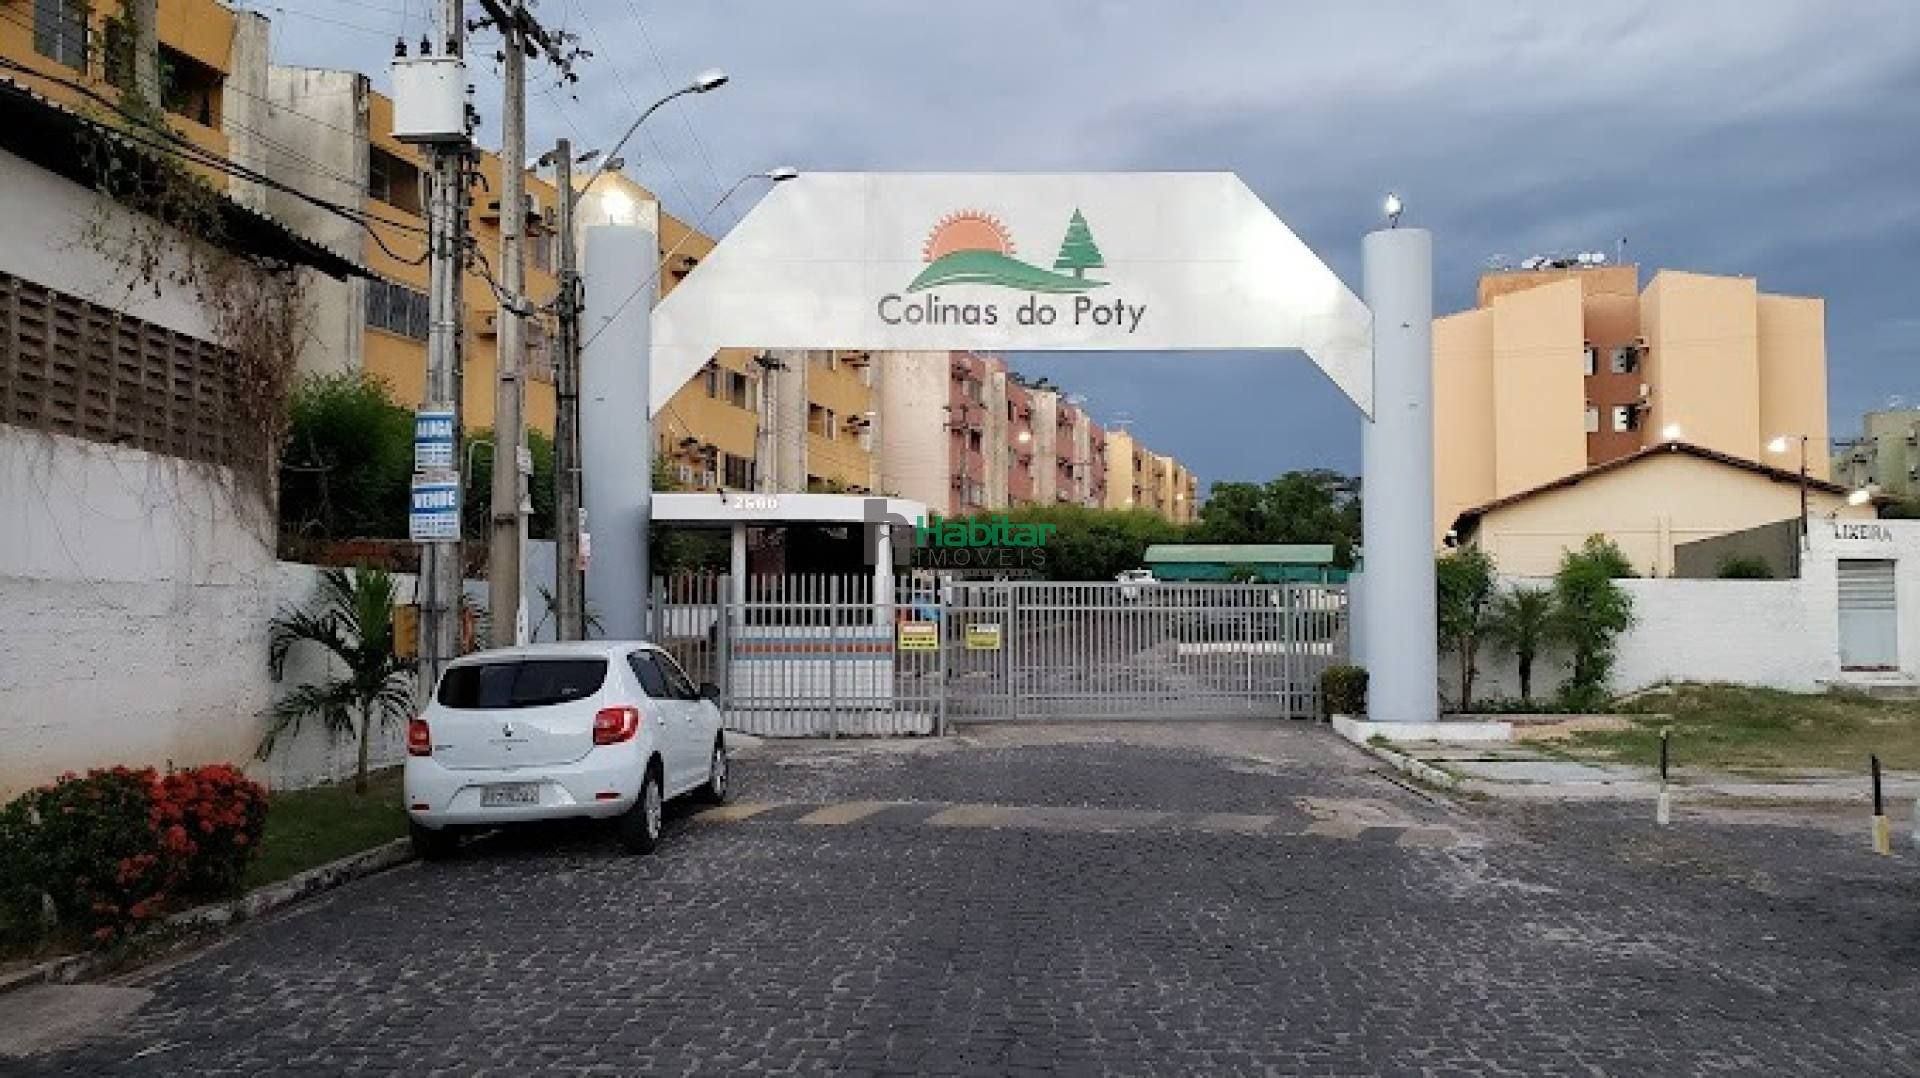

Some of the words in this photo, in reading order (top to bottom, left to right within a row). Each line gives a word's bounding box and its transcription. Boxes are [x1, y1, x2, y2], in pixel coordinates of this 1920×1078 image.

[878, 293, 998, 325] Colinas
[1015, 295, 1057, 325] do
[1074, 296, 1147, 334] Poty
